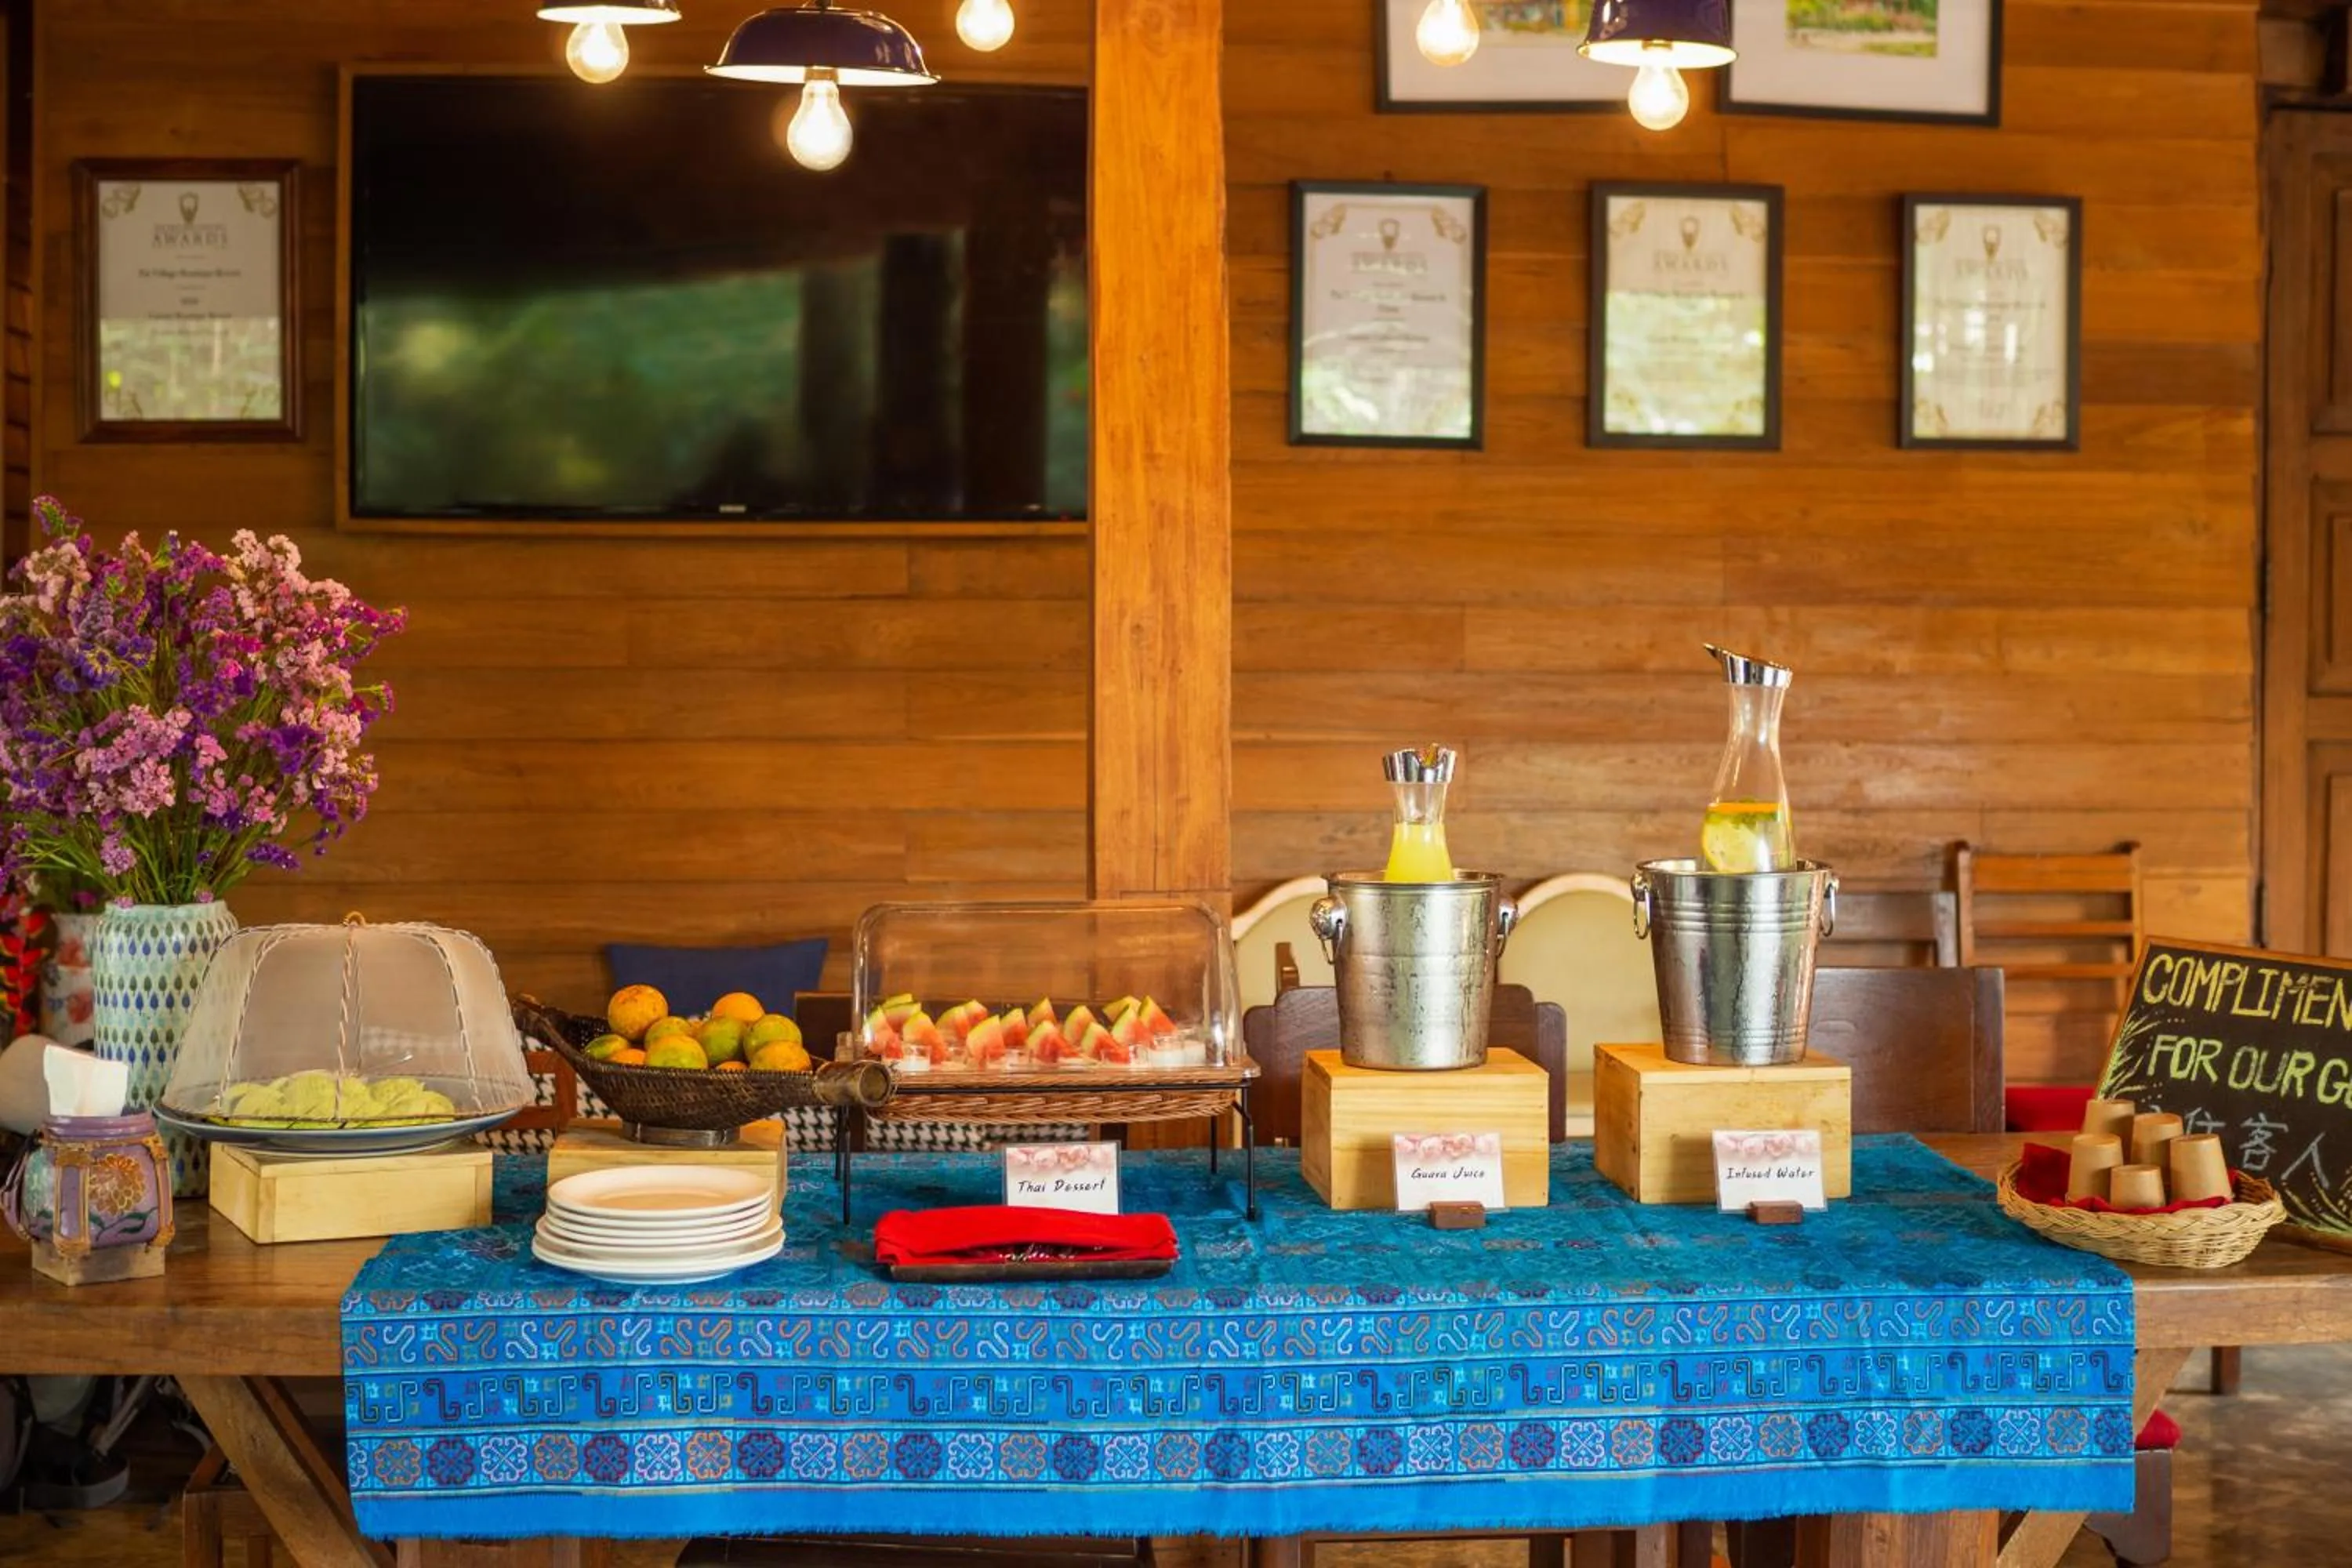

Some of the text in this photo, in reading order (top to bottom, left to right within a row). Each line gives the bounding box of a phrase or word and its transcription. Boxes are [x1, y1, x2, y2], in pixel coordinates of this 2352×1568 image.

[2143, 953, 2352, 1031] COMPLIMEN
[2147, 1034, 2223, 1083] FOR
[2228, 1046, 2315, 1098] OUR
[1453, 1166, 1485, 1180] Juice
[1726, 1166, 1816, 1179] Infused Water
[1017, 1178, 1105, 1192] Thai Dessert
